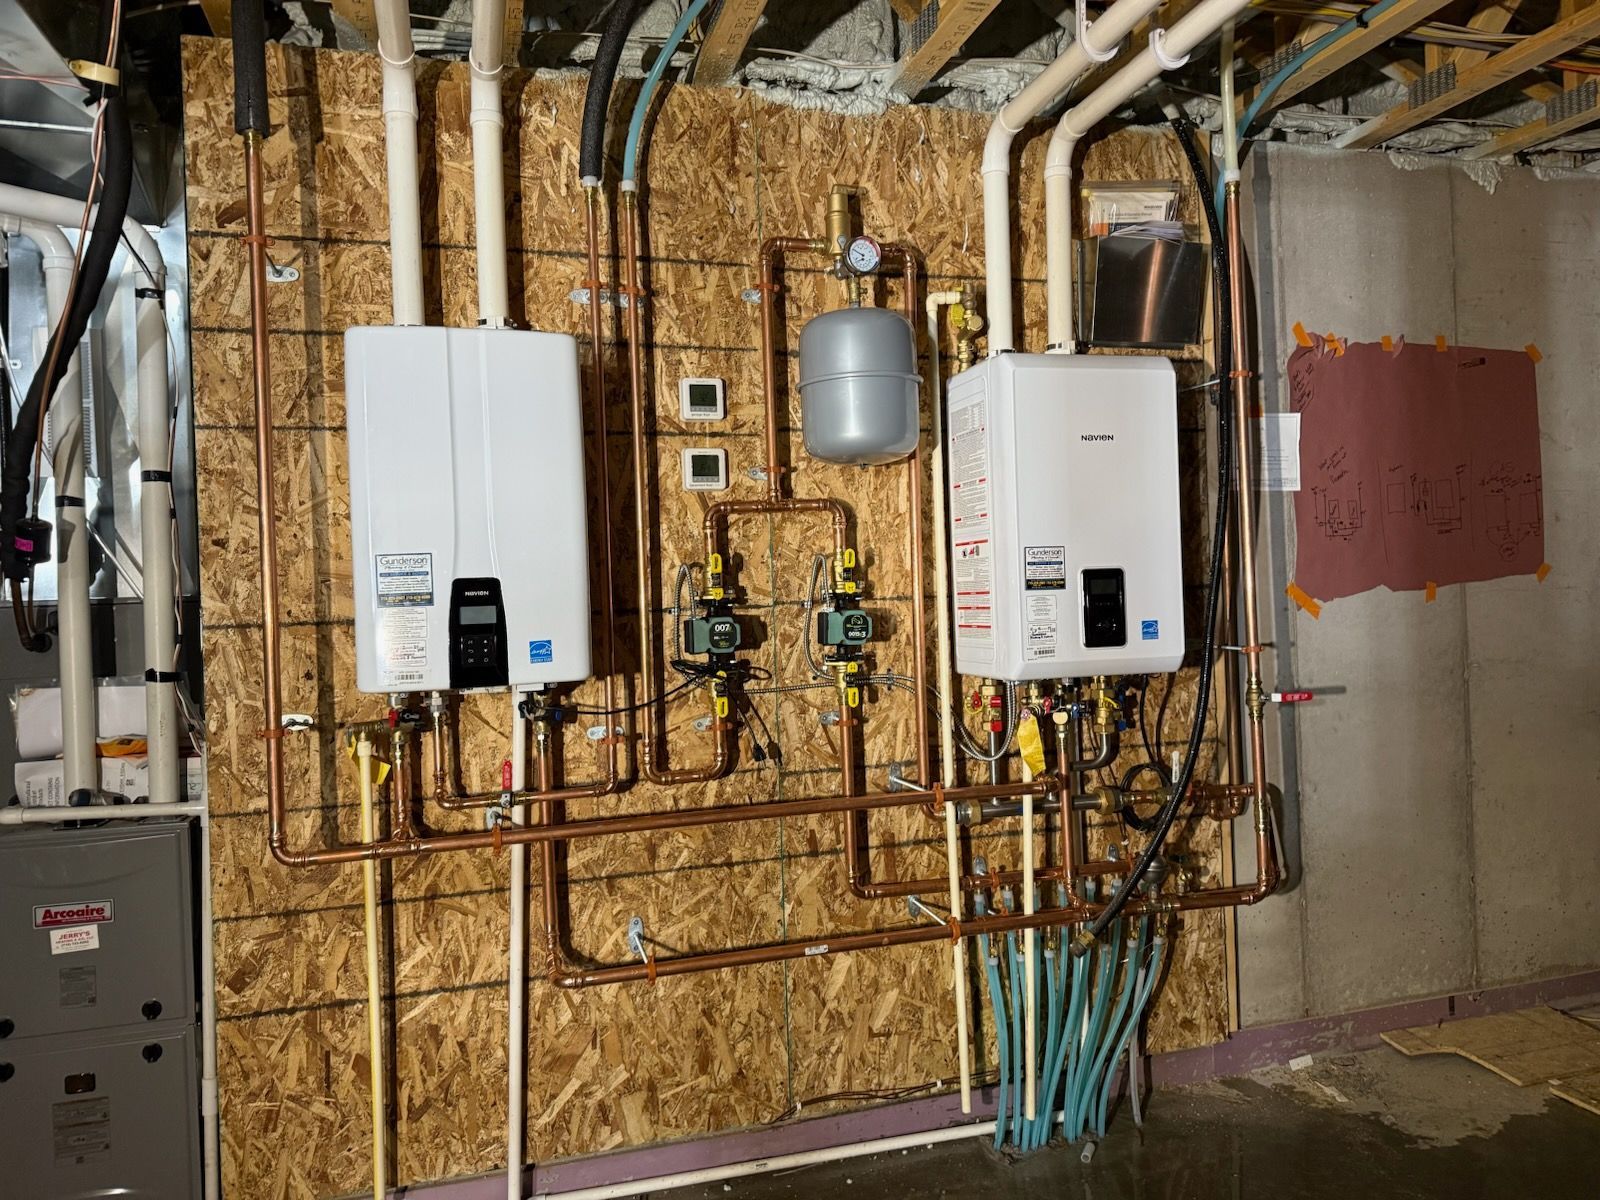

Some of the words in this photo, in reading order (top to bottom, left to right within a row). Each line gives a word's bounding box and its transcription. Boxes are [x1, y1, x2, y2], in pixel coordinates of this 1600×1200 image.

[1028, 548, 1062, 556] Gunderson
[380, 556, 428, 565] Gunderson
[42, 905, 105, 920] Arcoaire
[58, 931, 91, 940] JERRY'S
